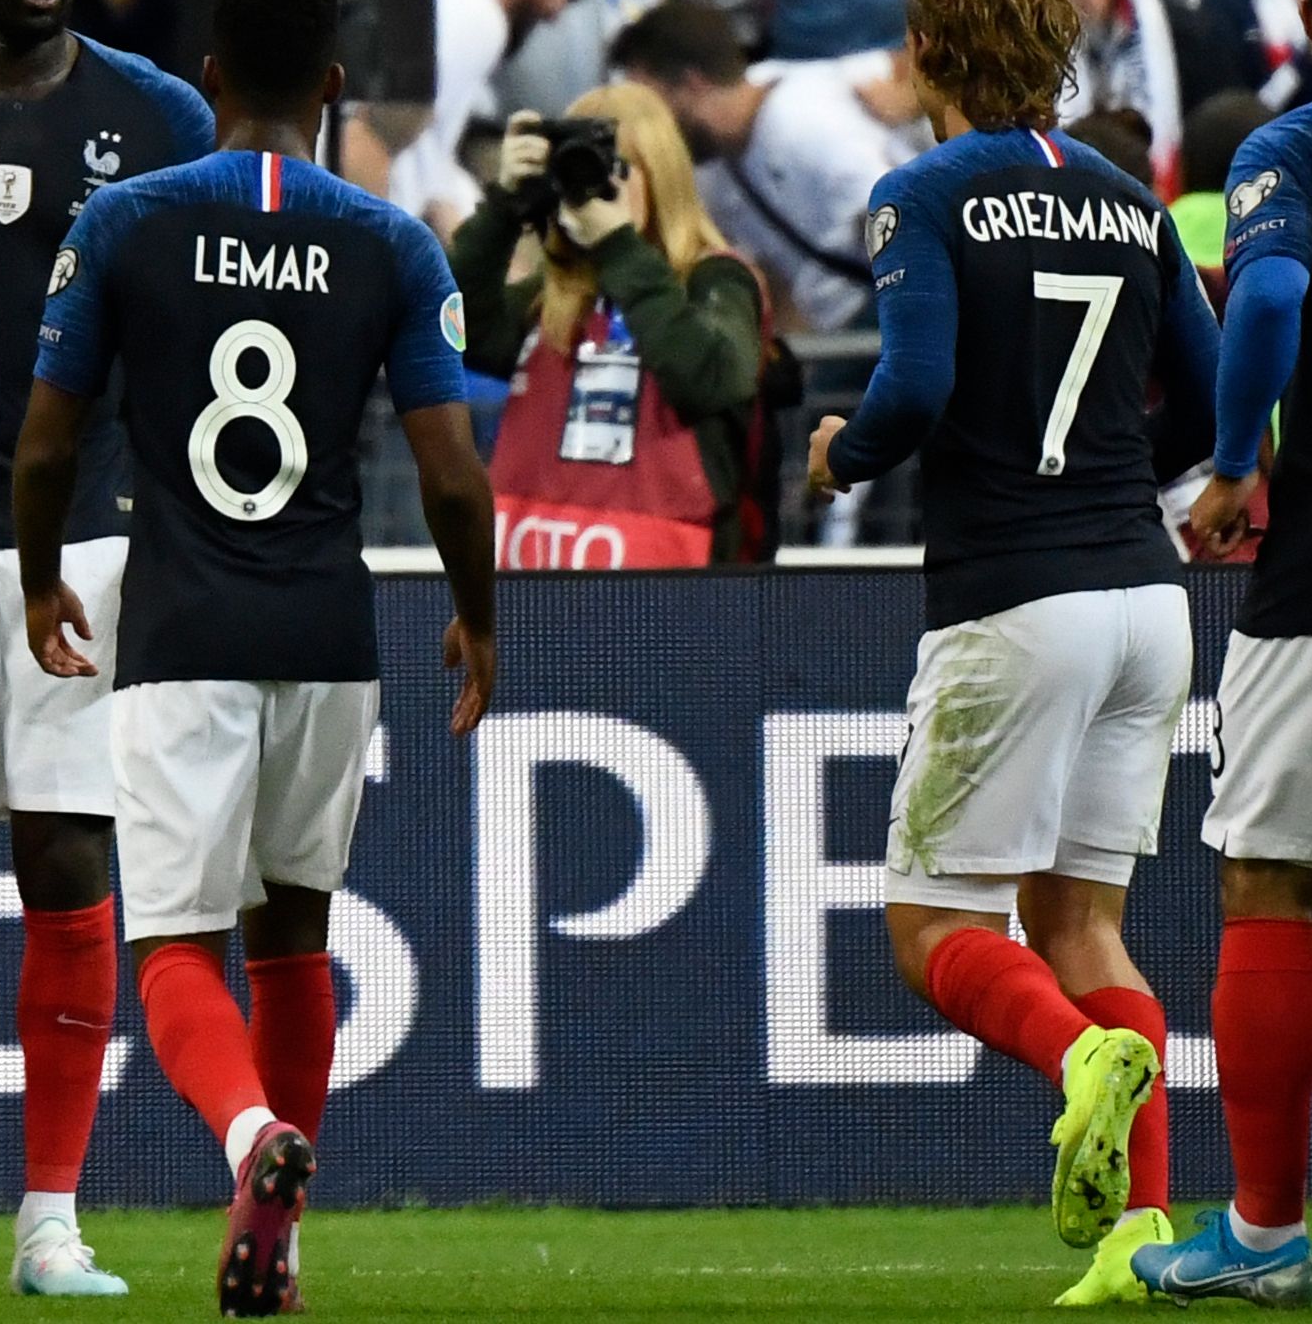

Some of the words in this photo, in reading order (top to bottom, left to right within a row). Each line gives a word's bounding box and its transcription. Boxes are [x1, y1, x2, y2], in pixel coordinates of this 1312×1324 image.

[194, 235, 330, 294] LEMAR
[962, 191, 1162, 257] GRIEZMANN
[188, 319, 308, 522] 8
[1033, 270, 1125, 476] 7
